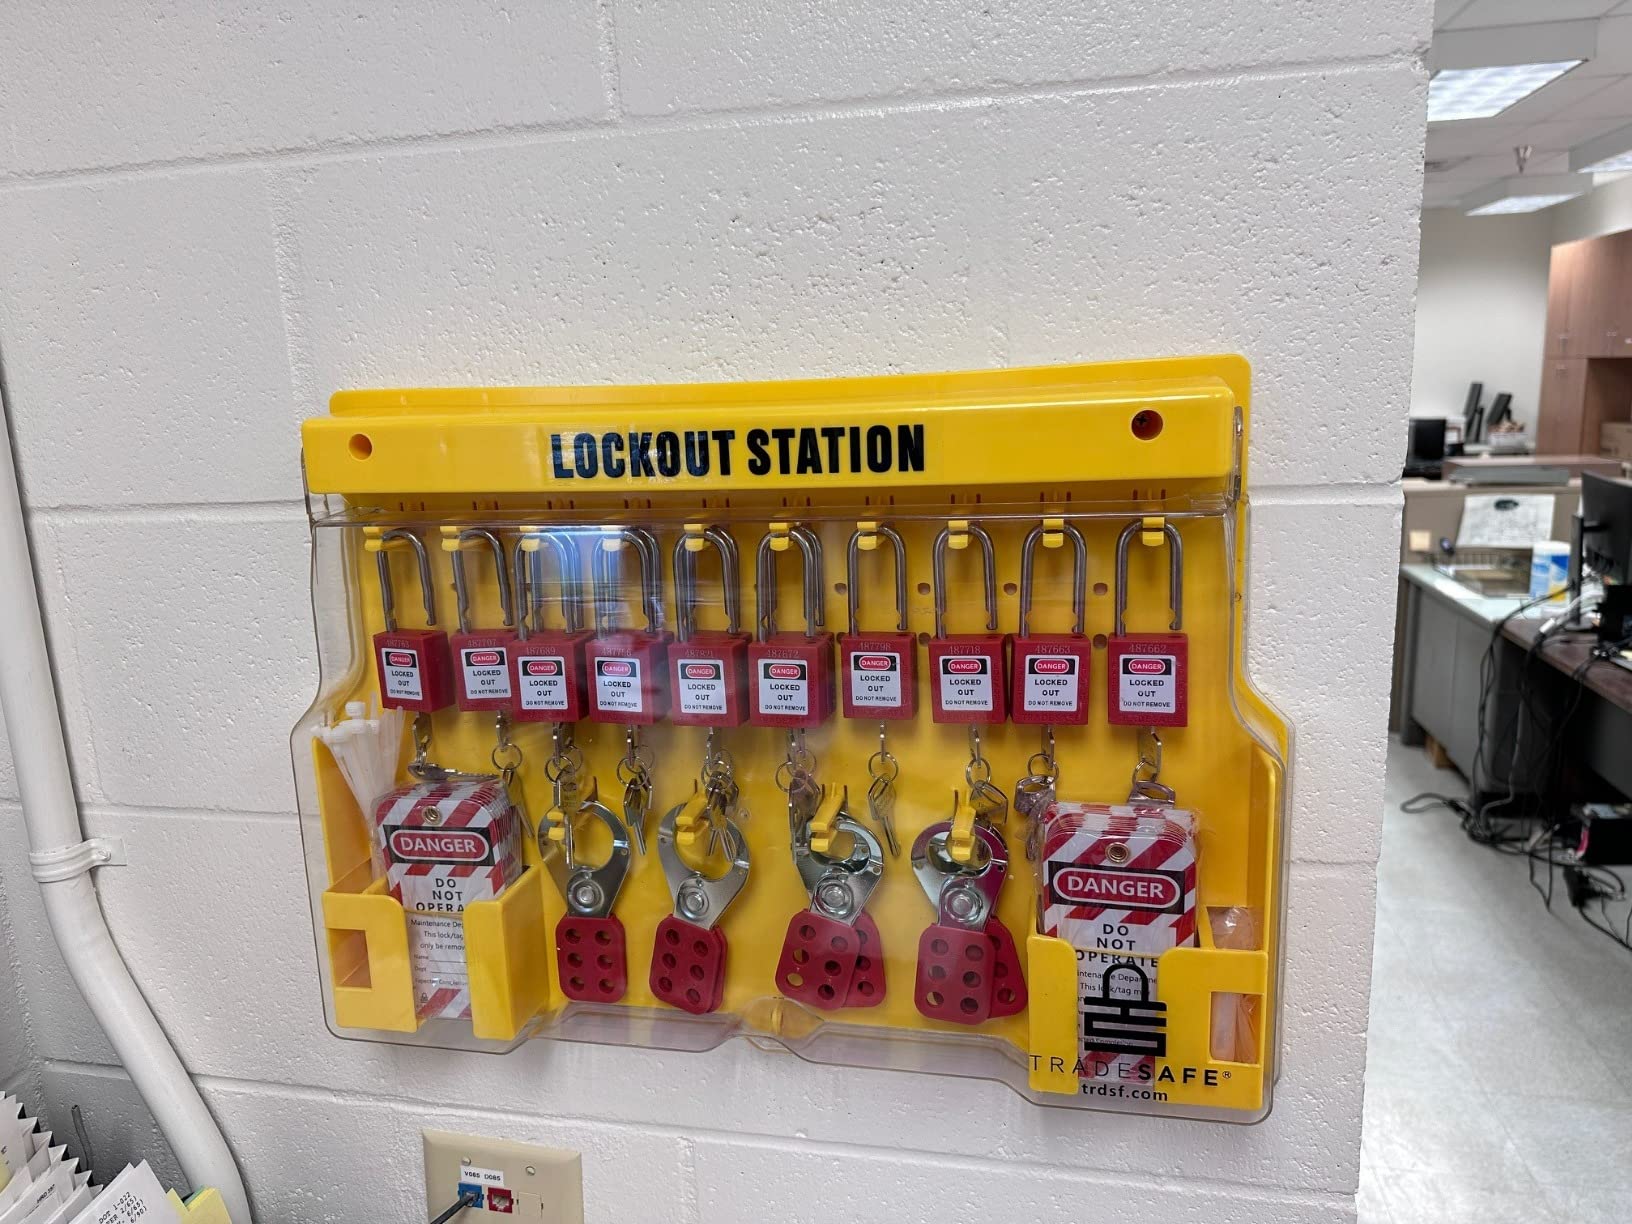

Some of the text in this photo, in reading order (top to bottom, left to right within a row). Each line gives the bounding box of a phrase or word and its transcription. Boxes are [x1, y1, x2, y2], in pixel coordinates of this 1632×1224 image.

[549, 424, 925, 479] LOCKOUT STATION
[472, 654, 497, 662] DANGER
[391, 670, 415, 678] LOCKED
[472, 669, 501, 677] LOCKED
[603, 680, 632, 688] LOCKED
[1034, 679, 1068, 687] LOCKED
[1129, 679, 1165, 687] LOCKED
[400, 837, 477, 852] DANGER
[435, 878, 457, 888] DO
[1066, 876, 1164, 898] DANGER
[432, 890, 463, 901] NOT
[411, 919, 451, 928] Maintenance
[1103, 923, 1129, 936] DO
[424, 931, 437, 939] This
[420, 943, 434, 951] only
[1096, 937, 1136, 951] NOT
[1080, 982, 1096, 991] This
[1081, 1083, 1168, 1101] trdsf.com
[98, 1210, 111, 1224] DOT
